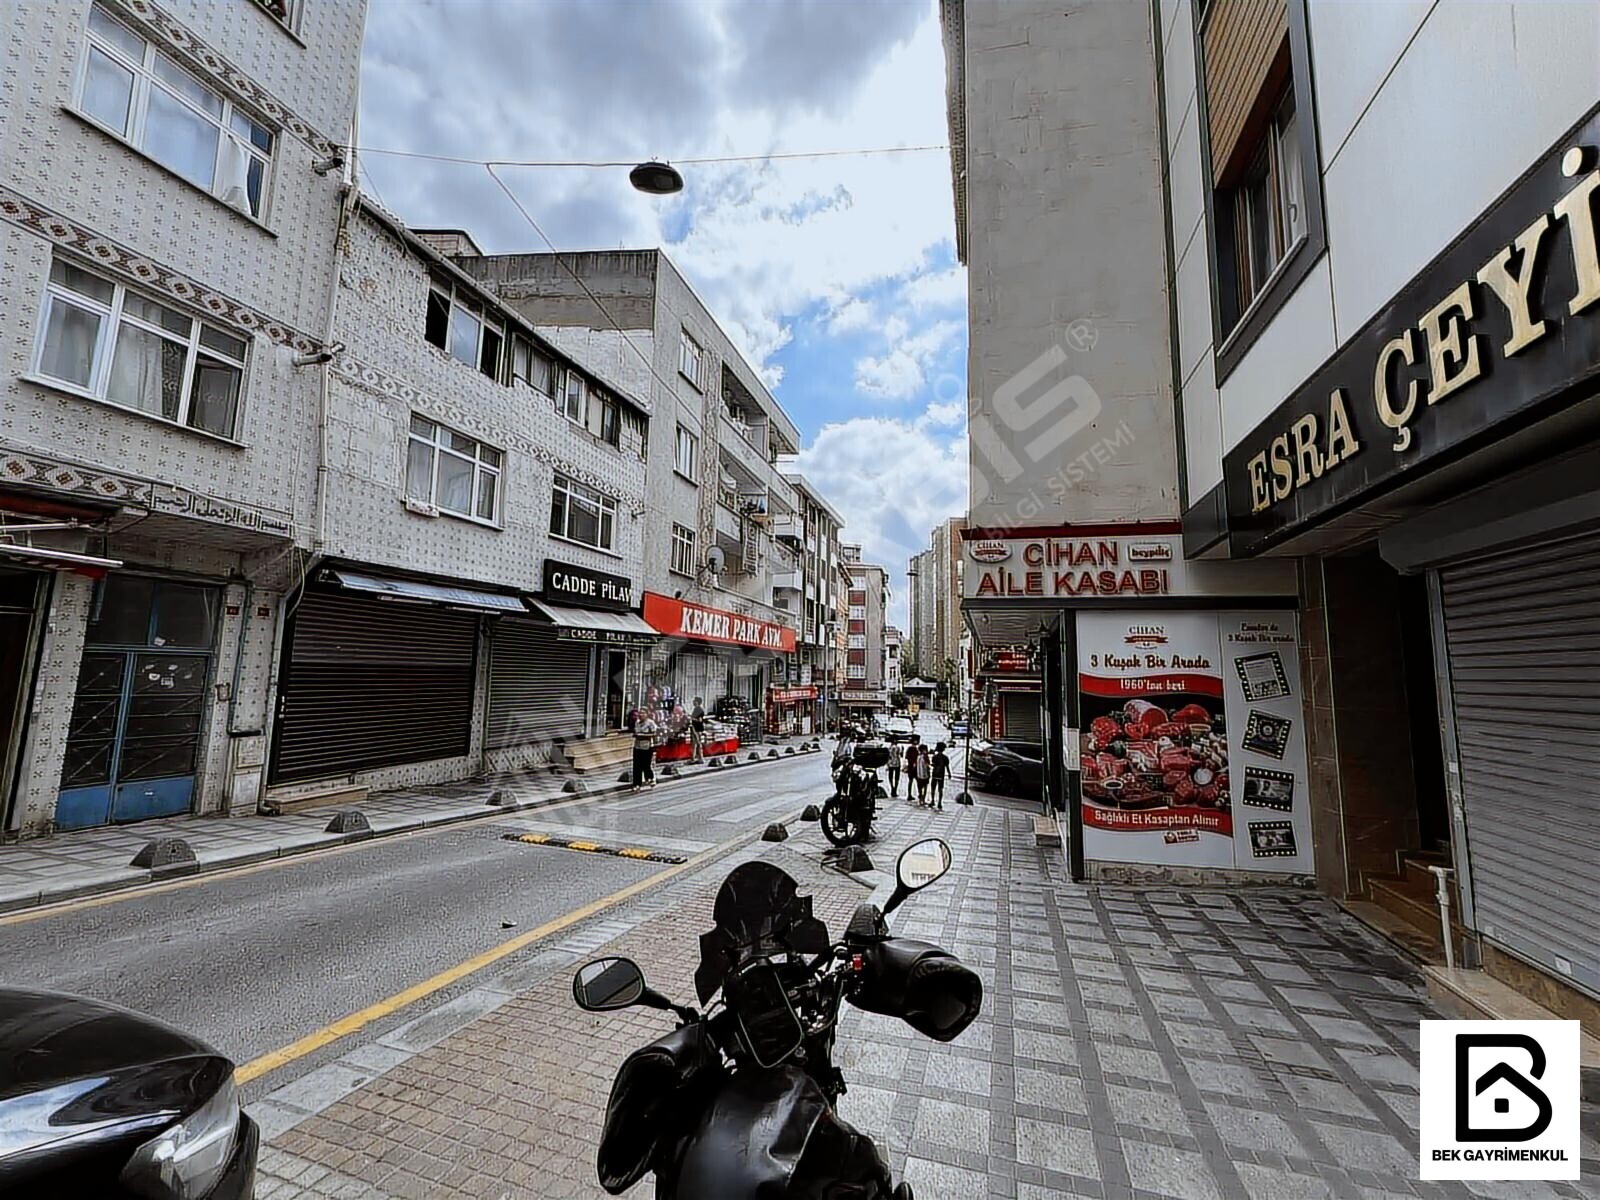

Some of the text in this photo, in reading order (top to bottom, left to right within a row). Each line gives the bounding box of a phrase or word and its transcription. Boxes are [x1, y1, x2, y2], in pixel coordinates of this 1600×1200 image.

[1247, 388, 1359, 513] ESRA
[1023, 538, 1119, 567] CİHAN
[552, 572, 633, 603] CADDE PİLAV
[976, 567, 1170, 596] AİLE KASABI
[680, 607, 730, 640] KEMER
[732, 617, 760, 642] PARK
[1090, 653, 1211, 670] 3 Kuşak Bir Arada
[1094, 810, 1219, 826] Sağlıklı Et Kasaptan Alınır
